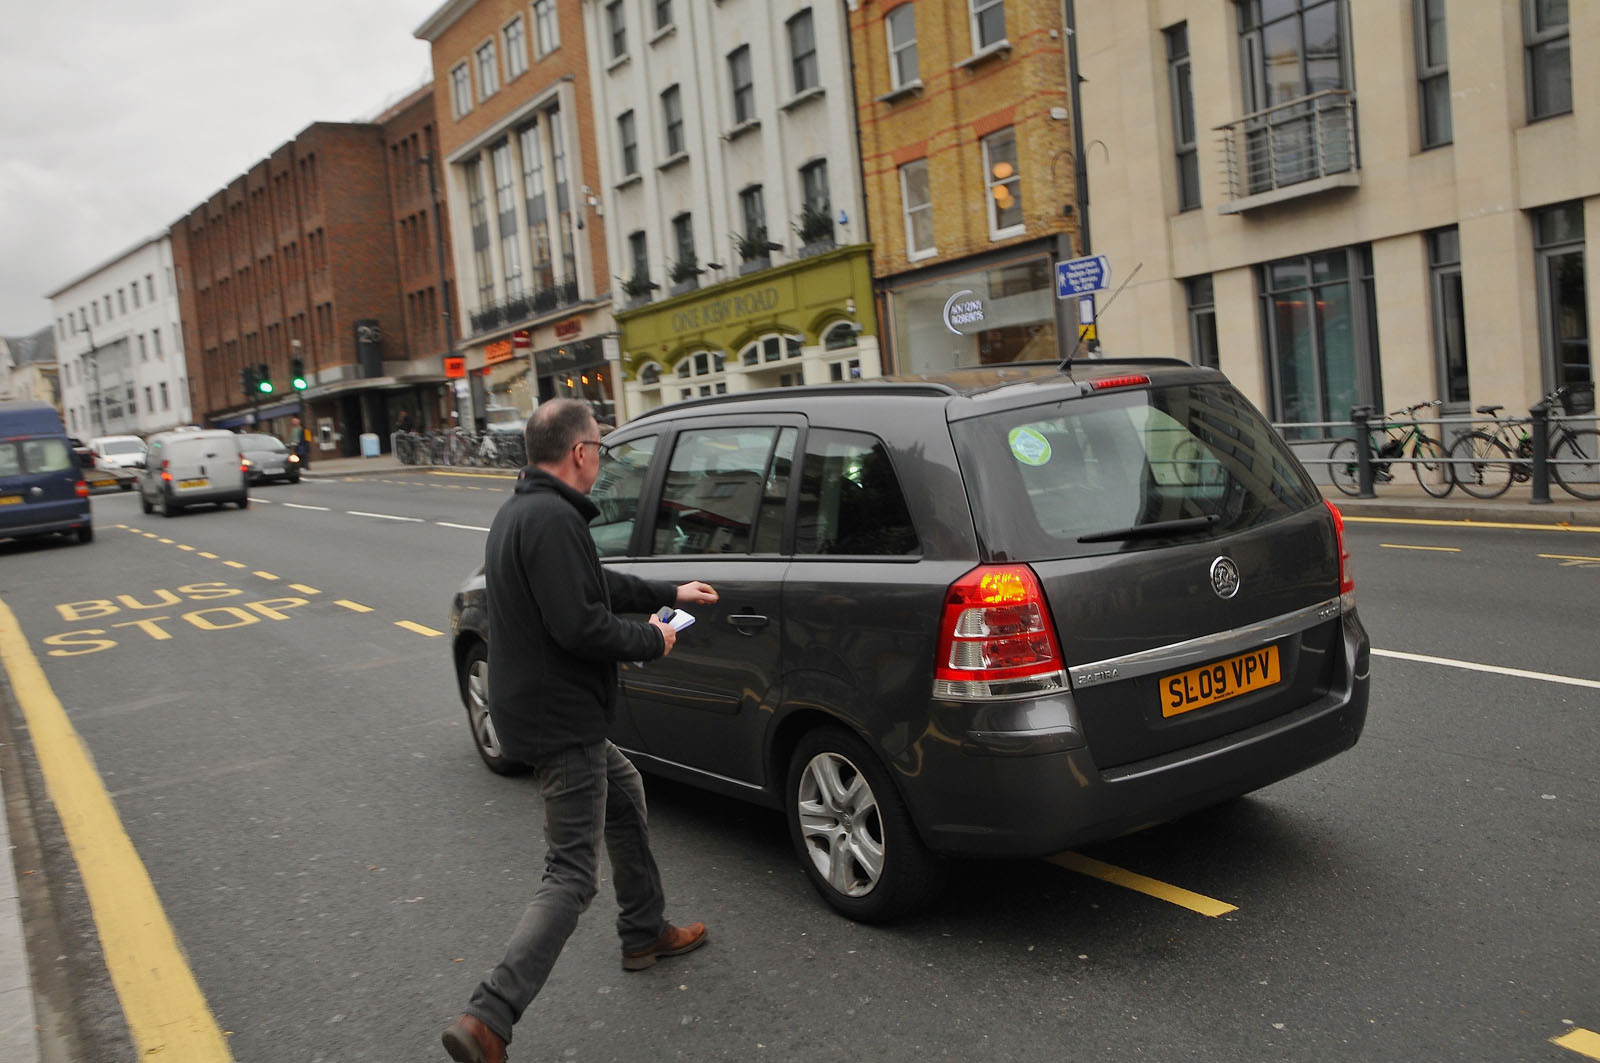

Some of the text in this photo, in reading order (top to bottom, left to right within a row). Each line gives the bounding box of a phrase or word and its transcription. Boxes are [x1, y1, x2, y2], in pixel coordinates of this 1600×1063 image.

[671, 287, 779, 333] ONE KEW ROAD
[55, 582, 244, 622] BUS
[43, 597, 311, 657] STOP
[1078, 668, 1119, 684] ZAFIRA
[1168, 651, 1269, 708] SL09 VPV
